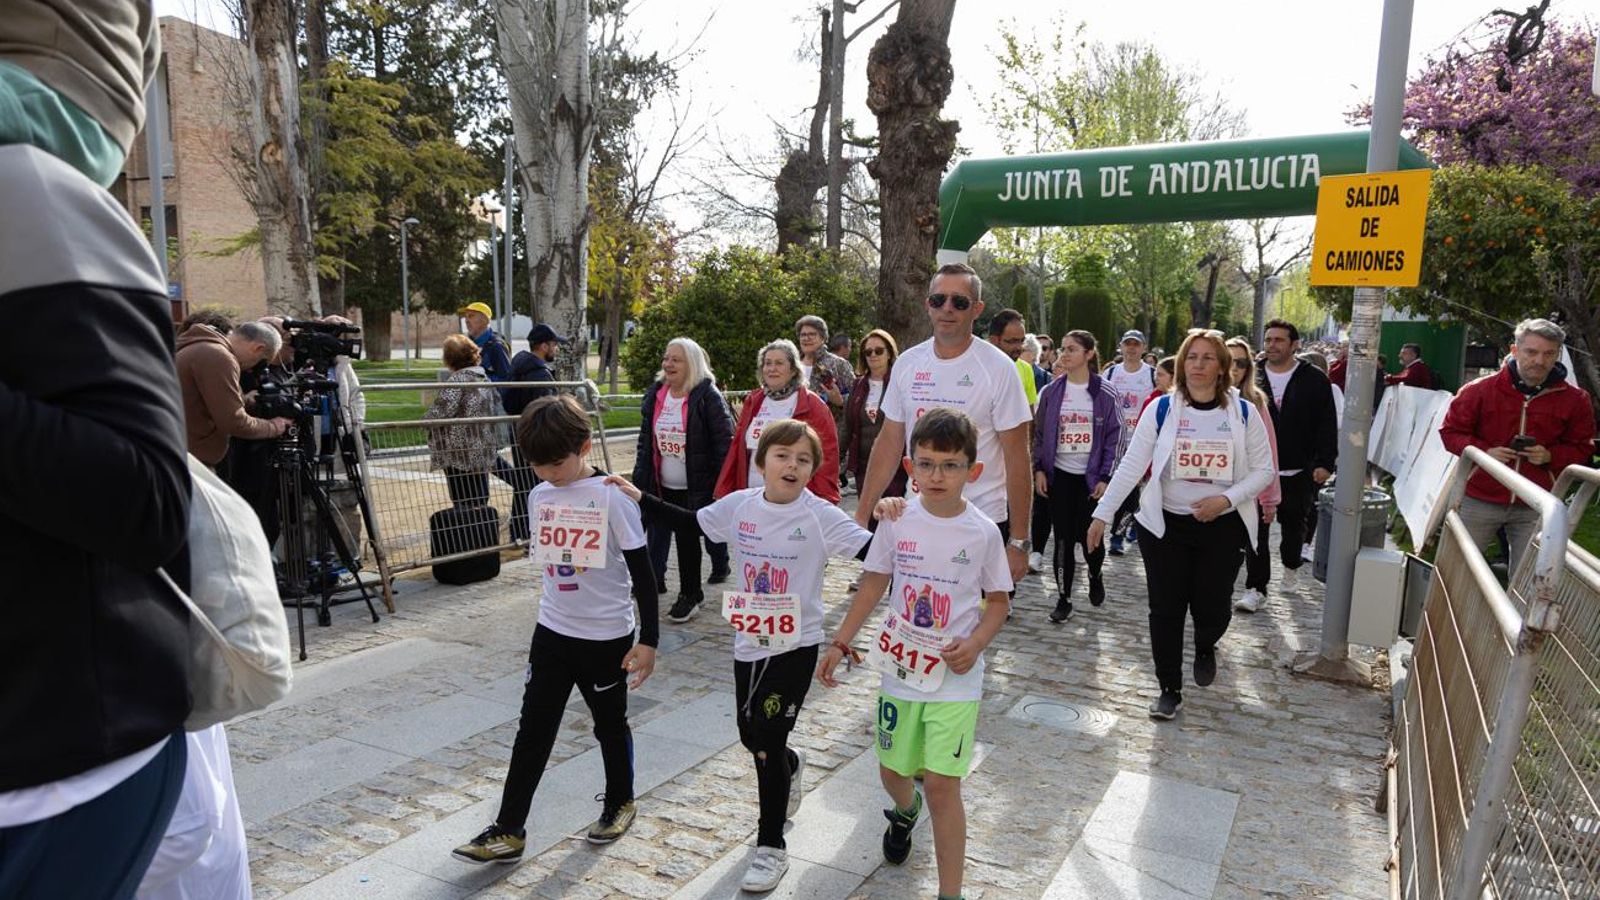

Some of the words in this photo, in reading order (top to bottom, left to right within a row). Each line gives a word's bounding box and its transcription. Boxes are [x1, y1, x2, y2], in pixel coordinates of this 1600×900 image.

[998, 168, 1083, 201] JUNTA
[1099, 165, 1134, 197] DE
[1345, 184, 1400, 208] SALIDA
[1360, 217, 1380, 238] DE
[1326, 250, 1405, 271] CAMIONES
[1060, 433, 1091, 445] 5528
[1178, 453, 1228, 468] 5073
[539, 526, 601, 550] 5072
[730, 613, 795, 635] 5218
[878, 630, 941, 675] 5417
[878, 696, 898, 732] 19
